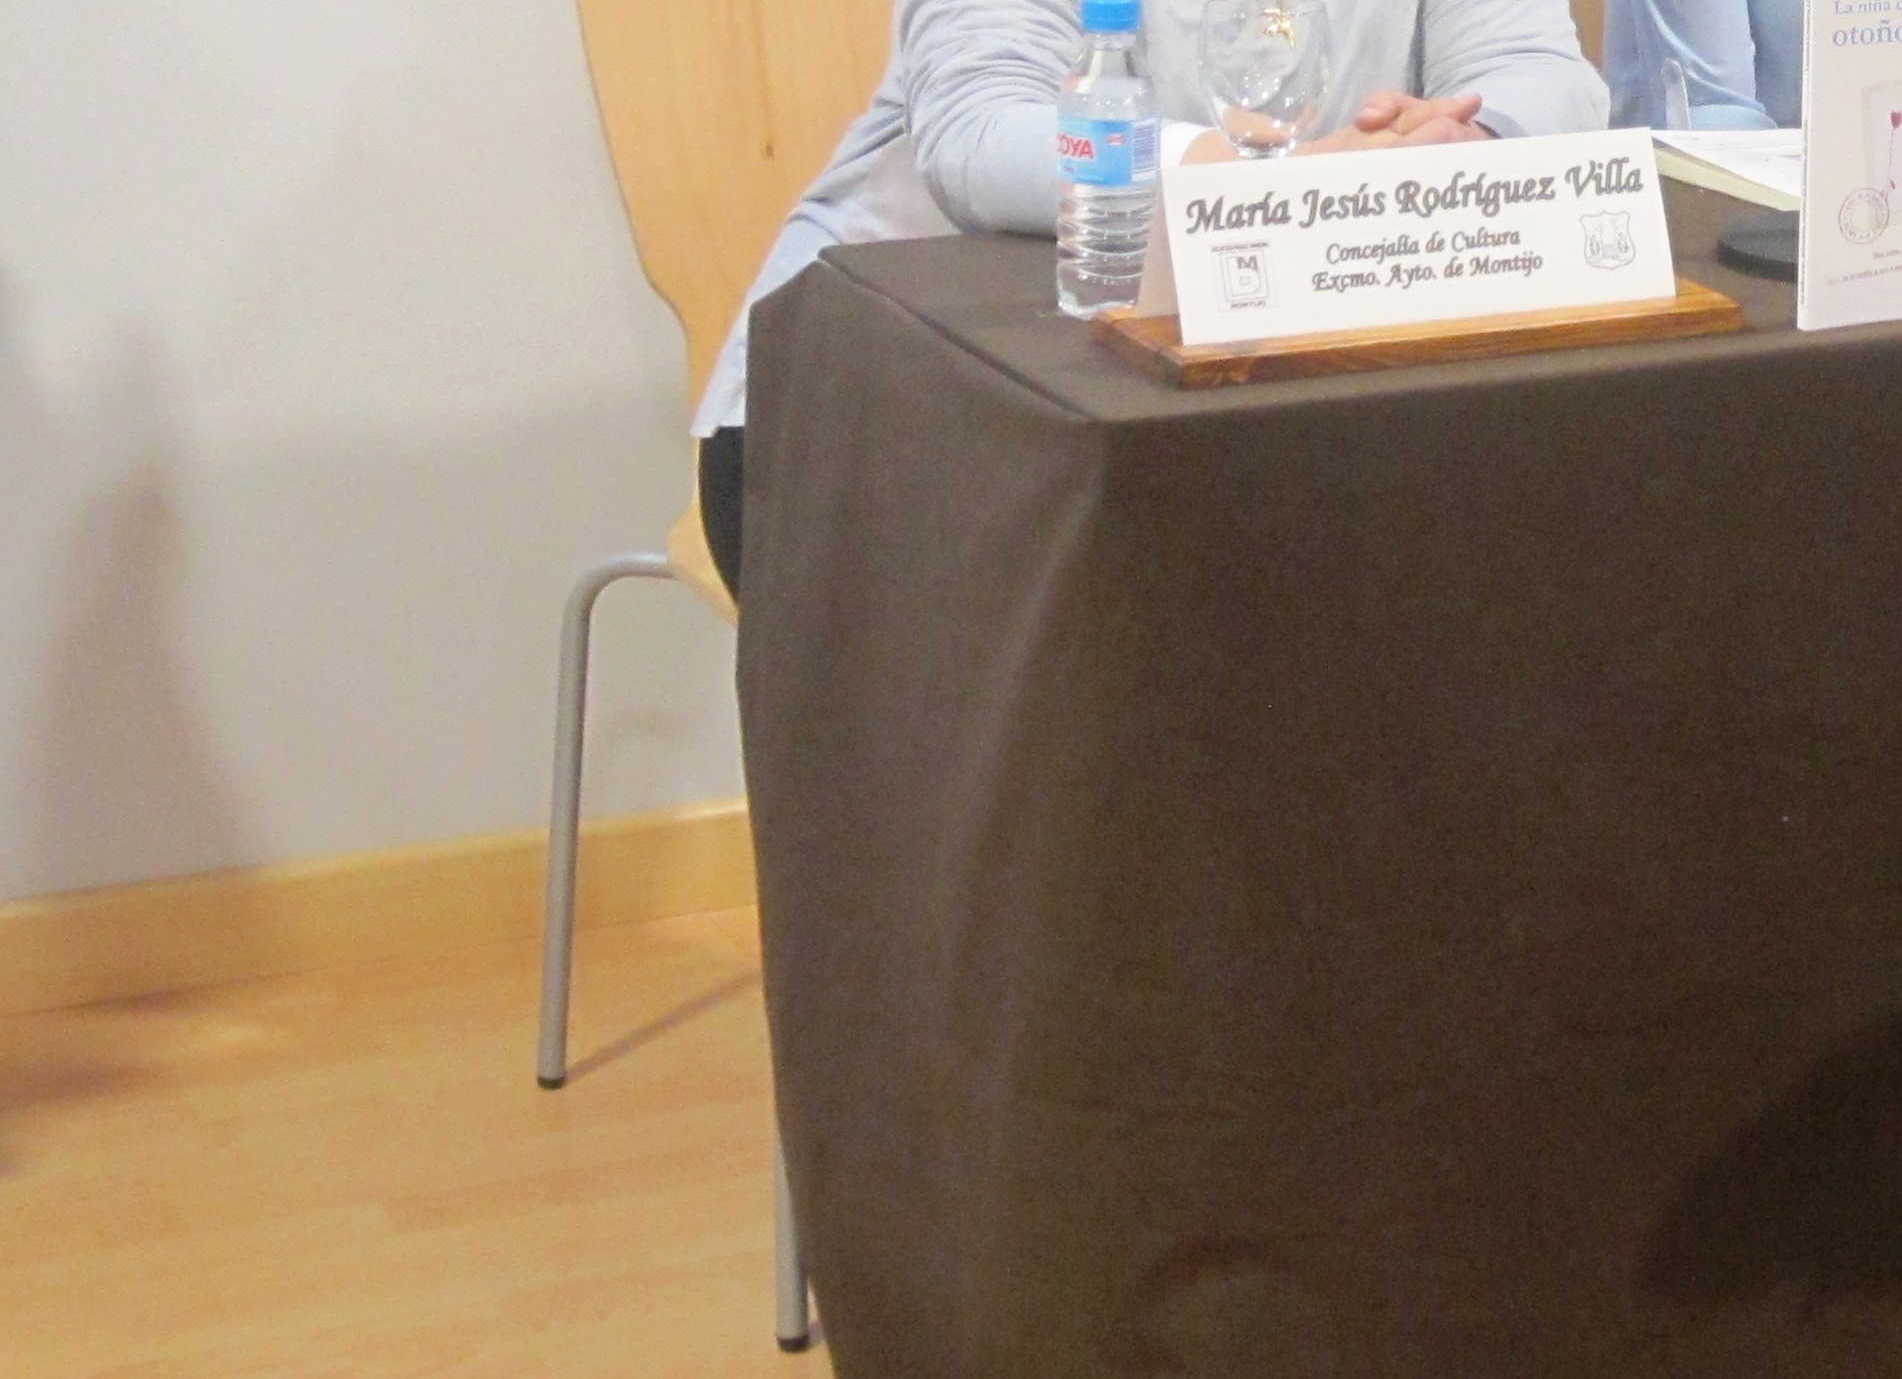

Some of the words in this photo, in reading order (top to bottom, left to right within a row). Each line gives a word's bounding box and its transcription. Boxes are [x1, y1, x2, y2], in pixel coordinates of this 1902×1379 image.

[1834, 0, 1853, 15] La
[1185, 191, 1292, 235] María
[1298, 183, 1387, 229] Jesús
[1394, 171, 1556, 219] Rodríguez
[1565, 157, 1644, 199] Villa
[1325, 233, 1420, 265] Concejalía
[1425, 231, 1446, 253] de
[1451, 226, 1521, 252] Cultura
[1312, 271, 1381, 293] Excmo.
[1385, 264, 1437, 289] Ayto.
[1443, 256, 1464, 279] de
[1468, 250, 1544, 277] Montijo
